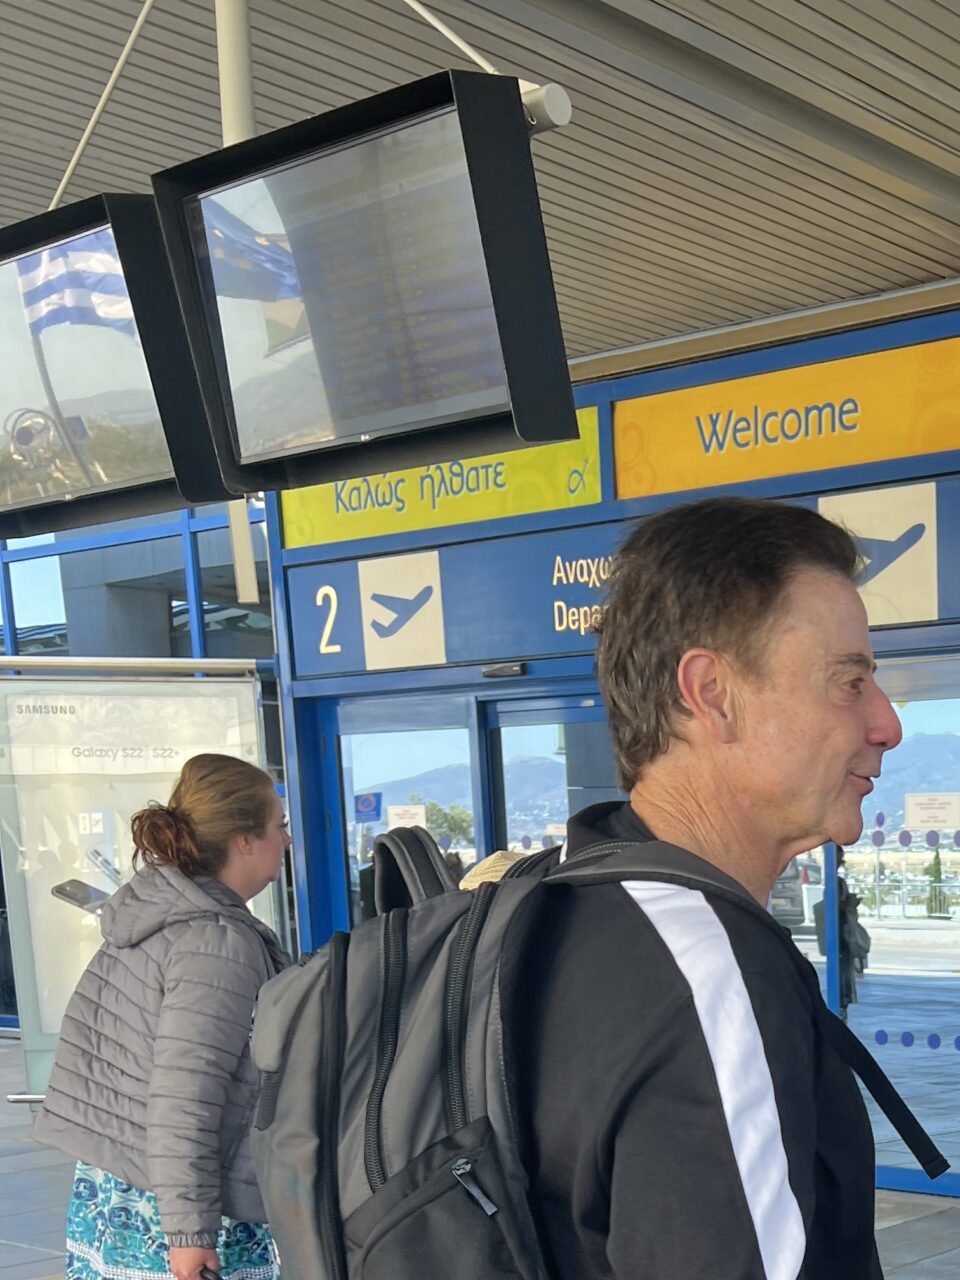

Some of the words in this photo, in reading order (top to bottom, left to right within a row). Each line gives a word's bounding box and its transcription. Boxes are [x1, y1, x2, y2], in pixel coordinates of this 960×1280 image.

[695, 398, 860, 454] Welcome
[334, 473, 406, 514] Καλώς
[419, 460, 507, 510] ήλθατε
[316, 585, 342, 654] 2
[16, 704, 77, 715] SAMSUNG
[71, 746, 119, 761] Galaxy
[121, 747, 144, 759] S22
[152, 747, 180, 759] S22+
